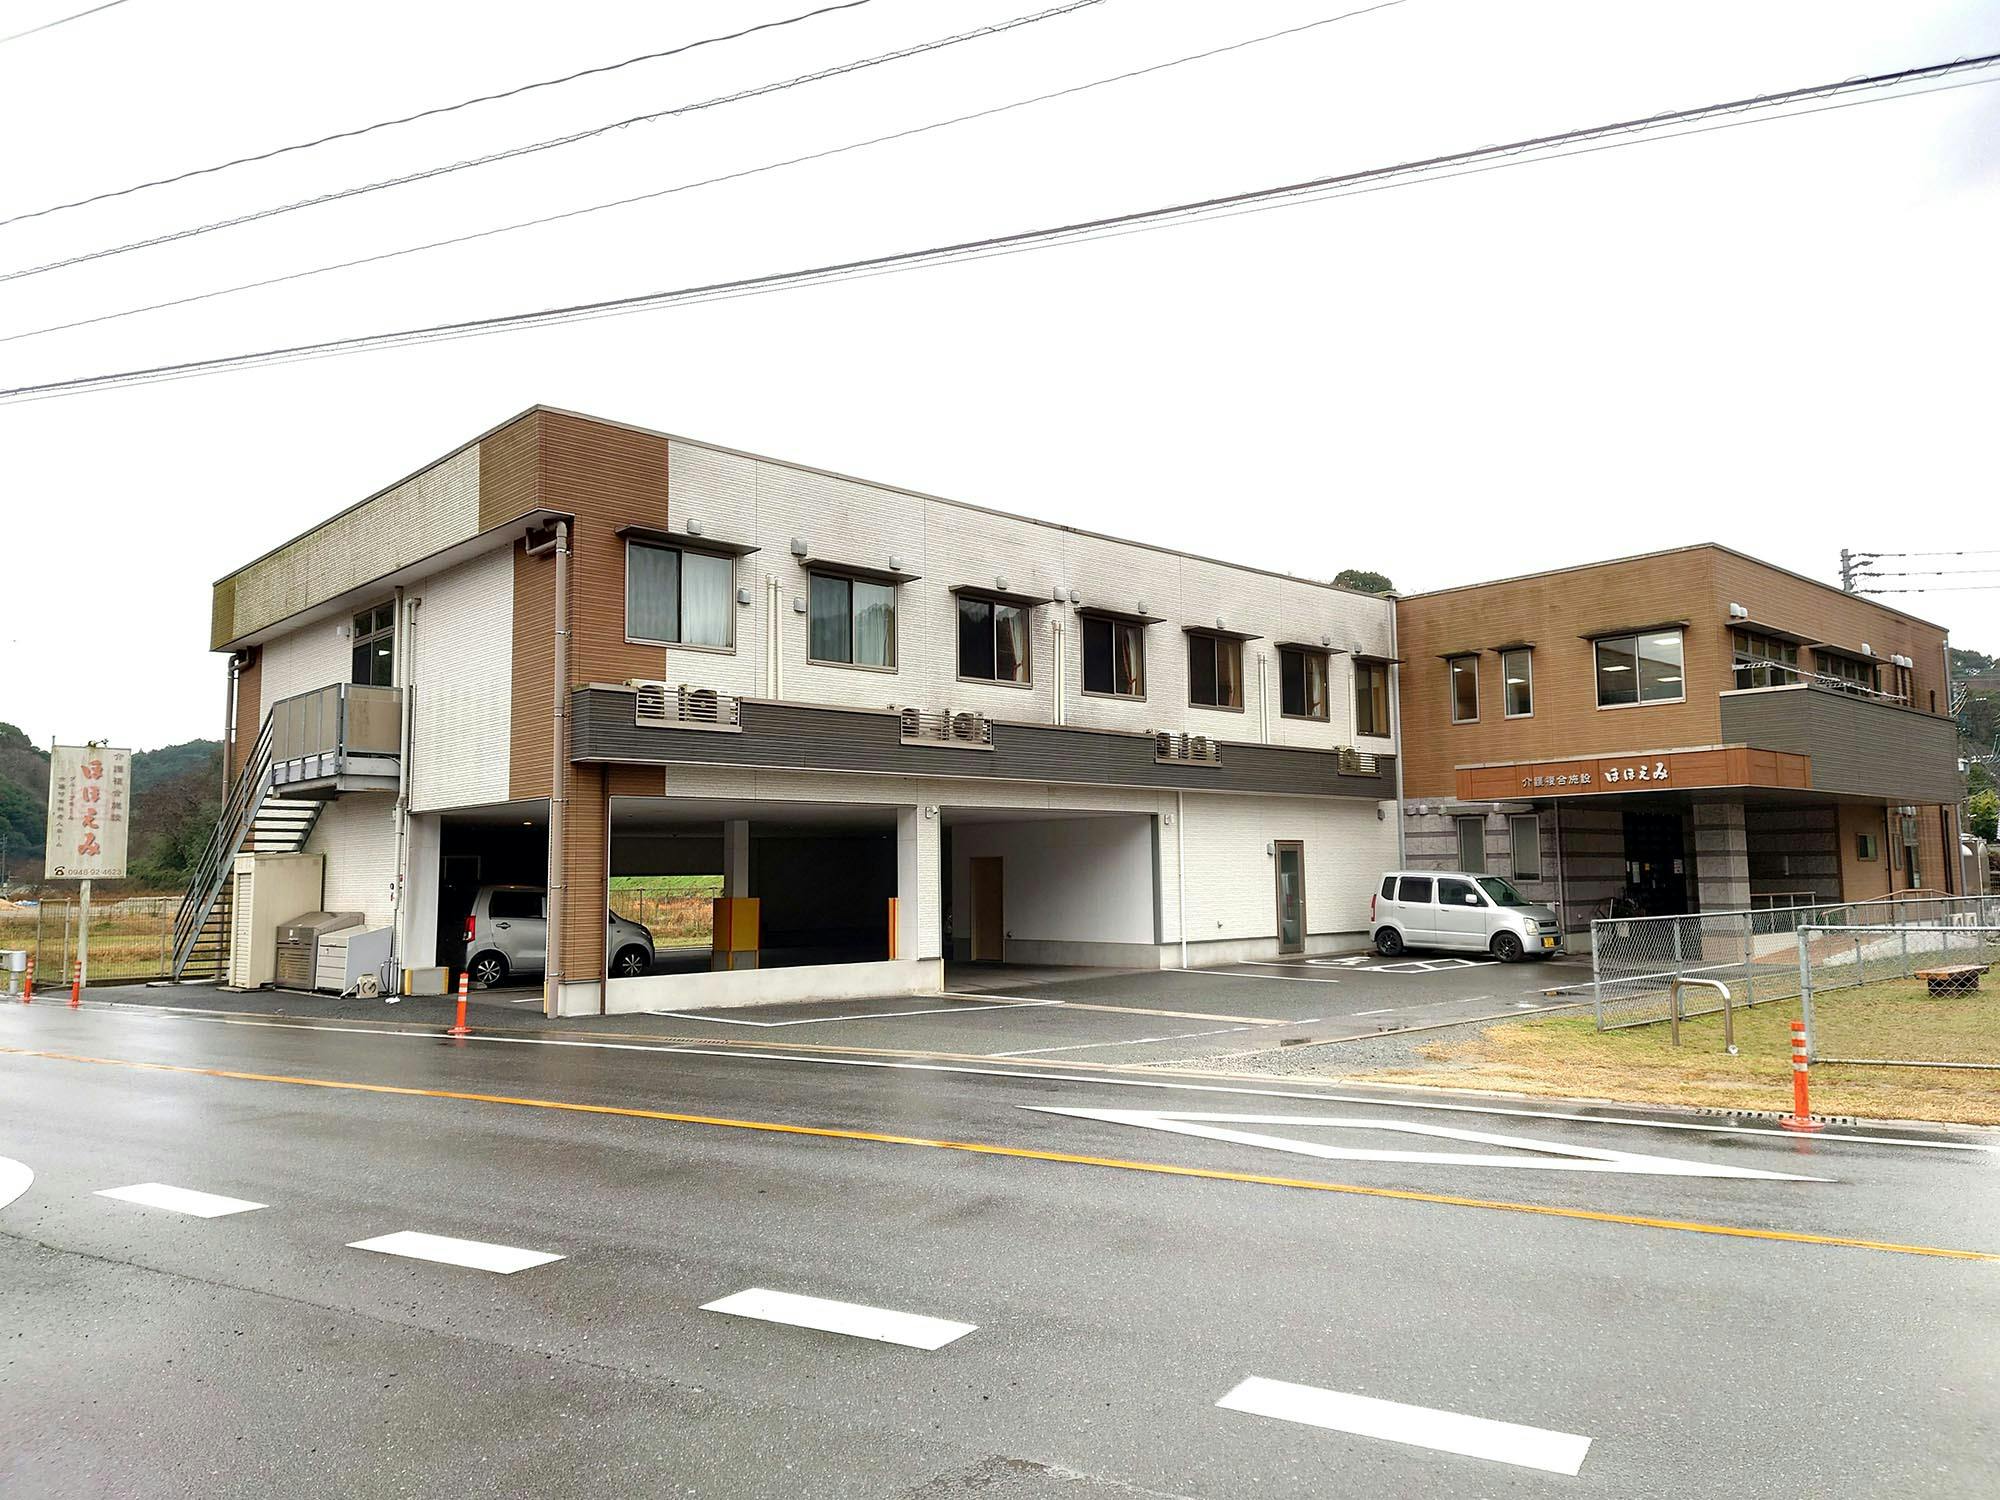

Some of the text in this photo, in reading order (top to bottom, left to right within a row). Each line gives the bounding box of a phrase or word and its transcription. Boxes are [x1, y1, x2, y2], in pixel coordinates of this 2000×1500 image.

[1604, 762, 1669, 782] ほほえみ
[78, 759, 104, 857] ほほえみ
